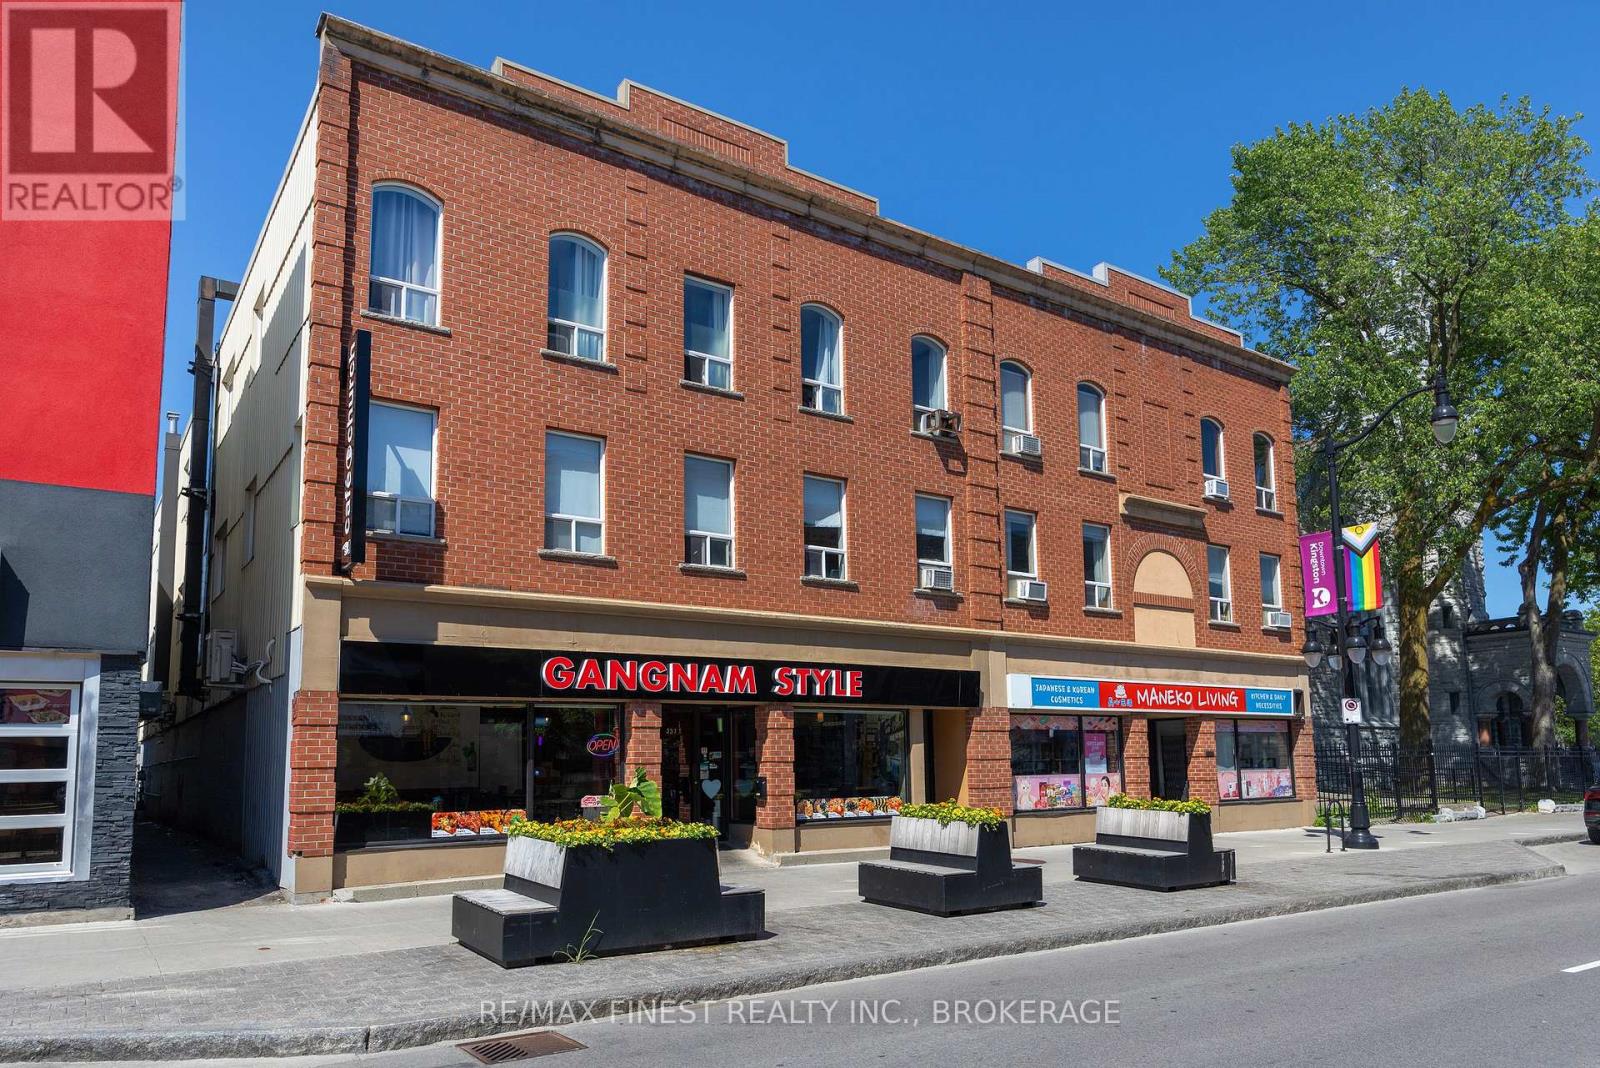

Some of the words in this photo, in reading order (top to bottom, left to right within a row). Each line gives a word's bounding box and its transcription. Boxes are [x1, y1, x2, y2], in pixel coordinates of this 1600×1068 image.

[347, 342, 356, 442] church
[1310, 543, 1320, 584] Kingston
[1318, 541, 1326, 576] Downtown
[542, 656, 758, 695] GANGNAM
[774, 666, 863, 697] STYLE
[1035, 684, 1066, 693] JAPANESE
[1066, 685, 1071, 693] &
[1072, 686, 1095, 694] KOREAN
[1050, 695, 1084, 705] COSMETICS
[1136, 689, 1193, 707] MANEKO
[1198, 691, 1239, 708] LIVING
[589, 739, 616, 751] OPEN
